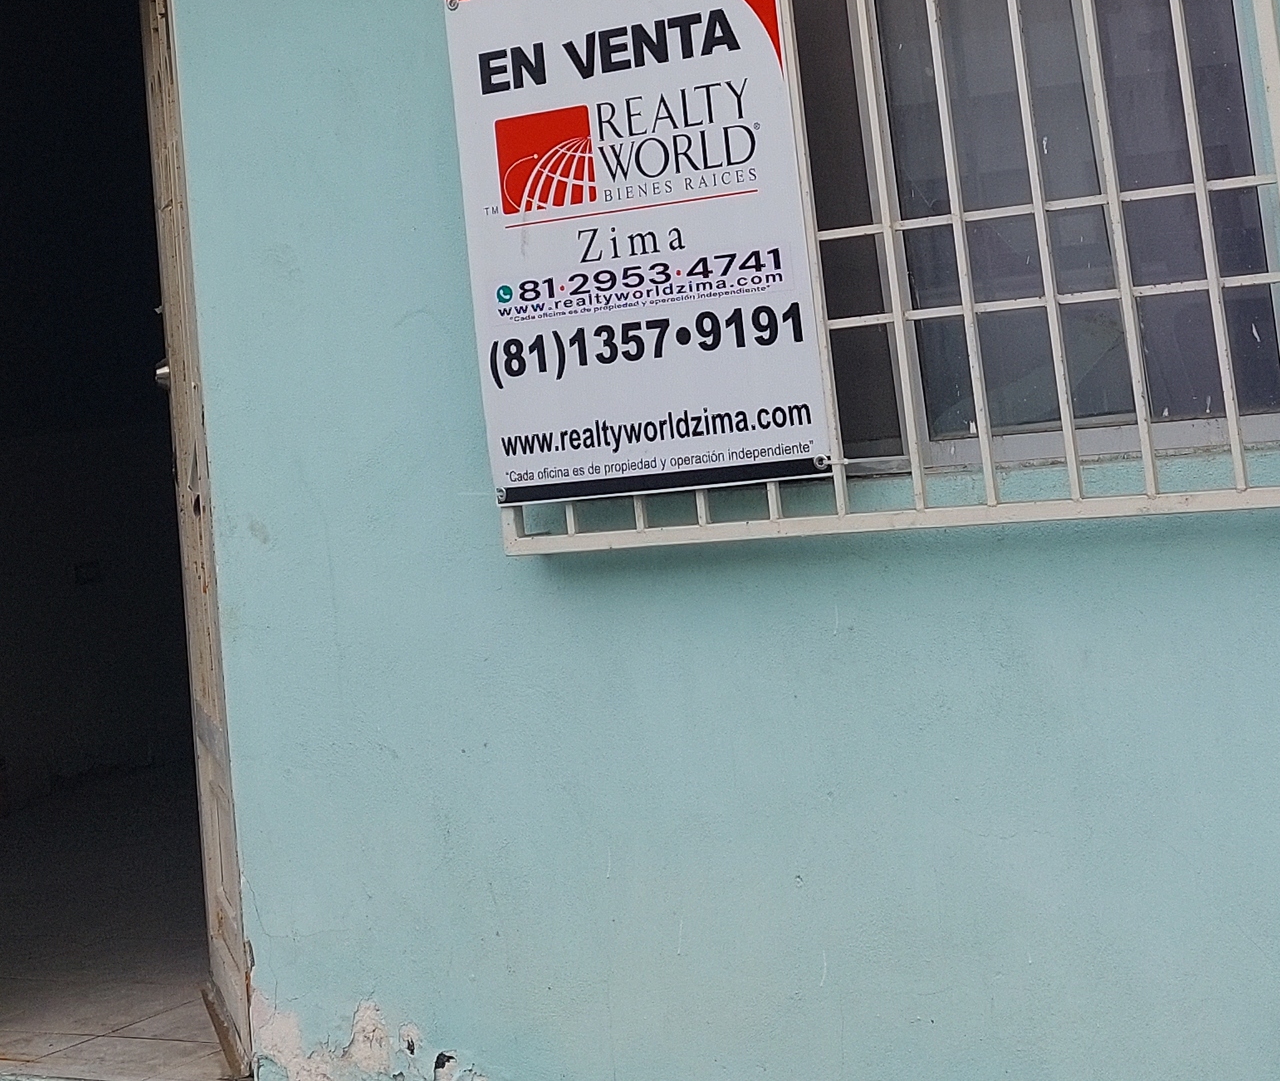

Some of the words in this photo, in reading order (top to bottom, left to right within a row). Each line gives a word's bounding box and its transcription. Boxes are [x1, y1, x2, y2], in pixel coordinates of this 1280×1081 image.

[478, 41, 547, 96] EN
[561, 8, 741, 80] VENTA
[596, 77, 749, 141] REALTY
[603, 179, 673, 202] BIENES
[684, 167, 758, 191] RAICES
[577, 226, 686, 264] Zima
[497, 272, 783, 317] www.realtyworldzima.com
[593, 300, 640, 313] propiedad
[501, 402, 812, 457] www.realtyworldzima.com
[537, 467, 570, 480] oficina
[572, 467, 585, 477] es
[587, 461, 601, 475] de
[604, 456, 657, 476] propiedad
[660, 458, 667, 470] y
[669, 451, 725, 469] operación
